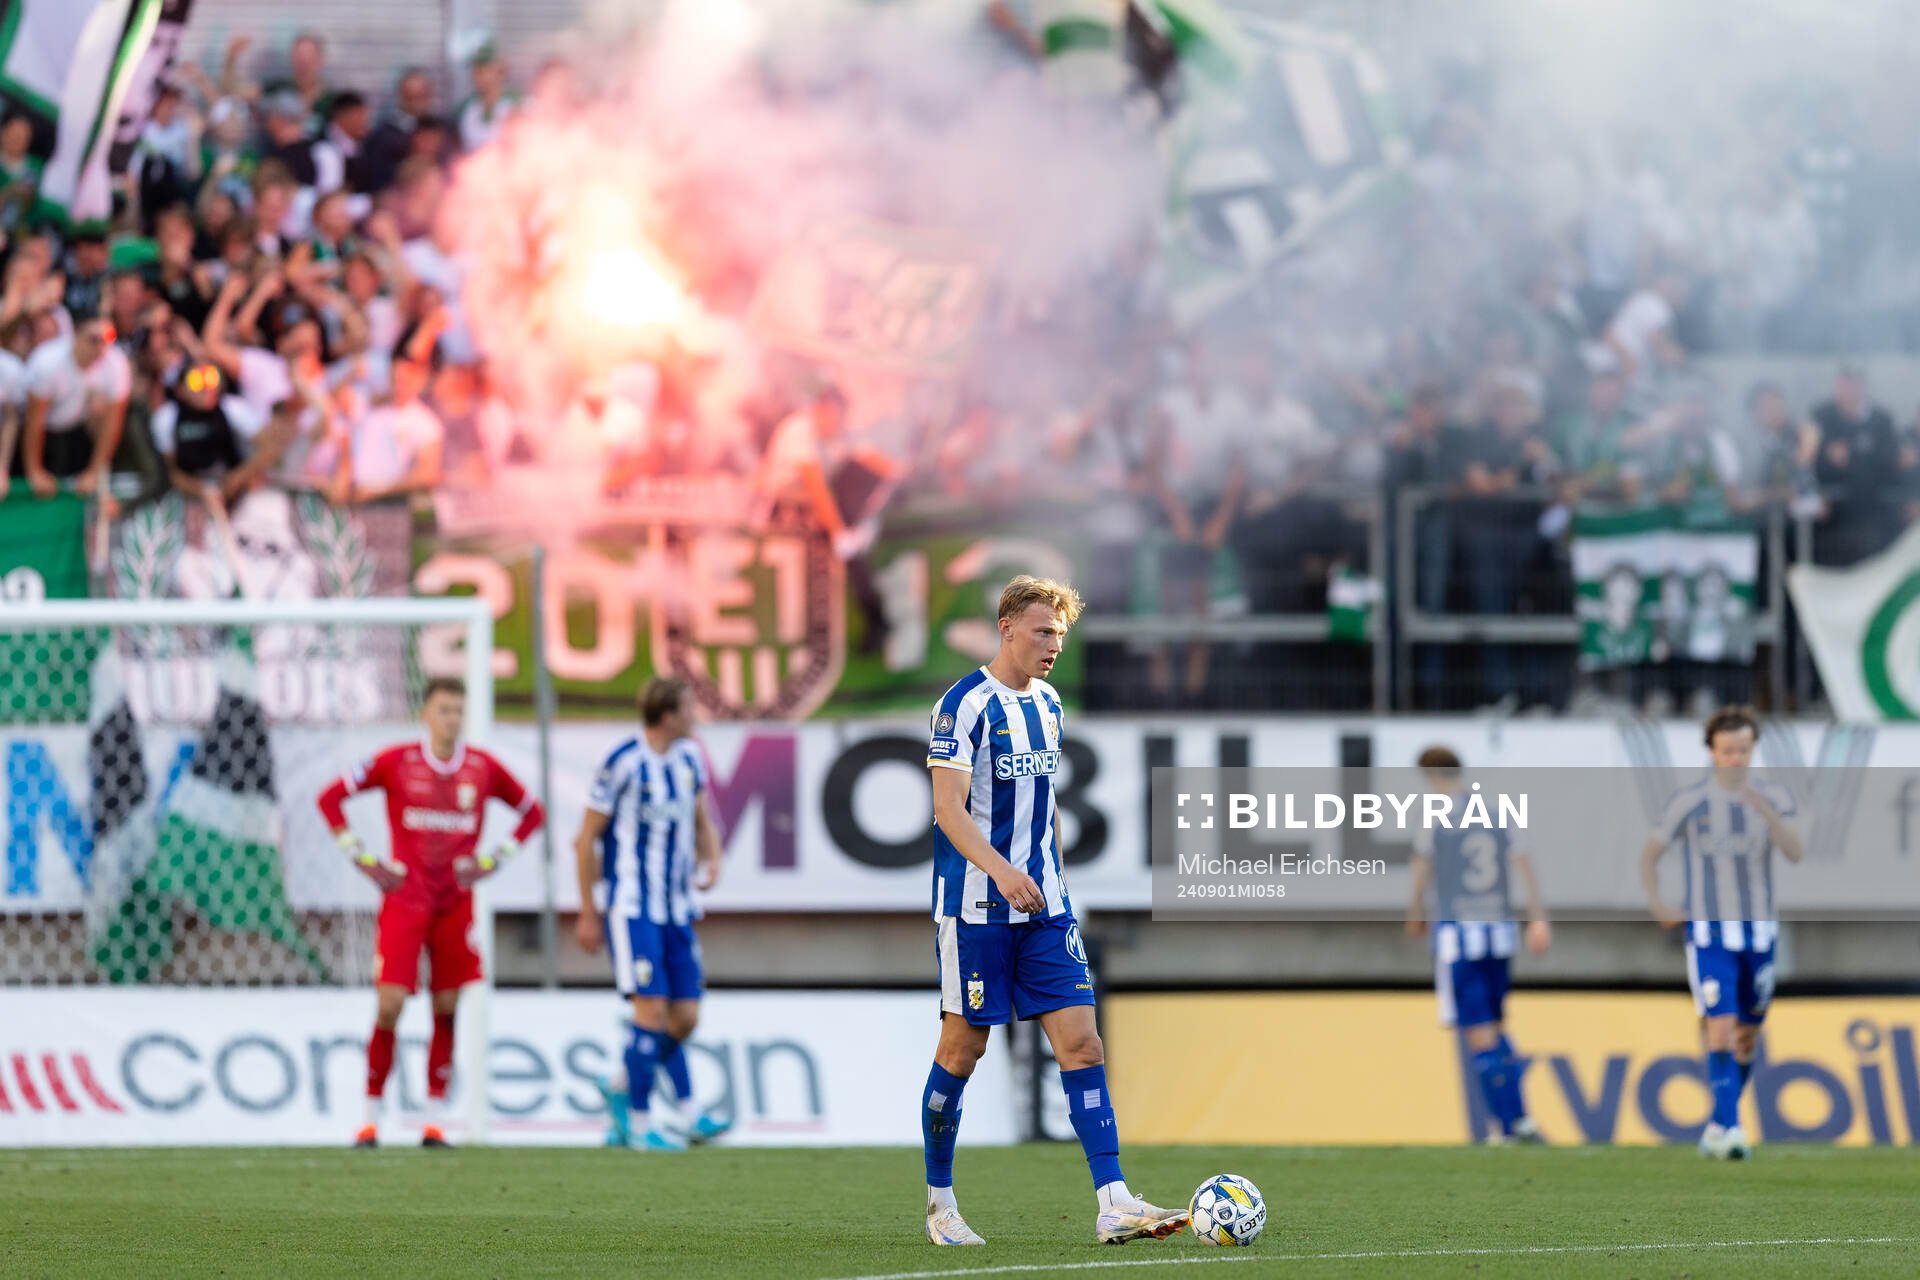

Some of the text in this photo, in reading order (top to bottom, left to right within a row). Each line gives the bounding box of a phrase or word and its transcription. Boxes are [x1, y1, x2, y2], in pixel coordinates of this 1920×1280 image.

[996, 727, 1020, 735] CRA
[996, 749, 1062, 780] SERNEK
[1460, 832, 1499, 893] 3
[119, 1022, 824, 1138] conesgn
[1239, 1206, 1266, 1235] SELECT
